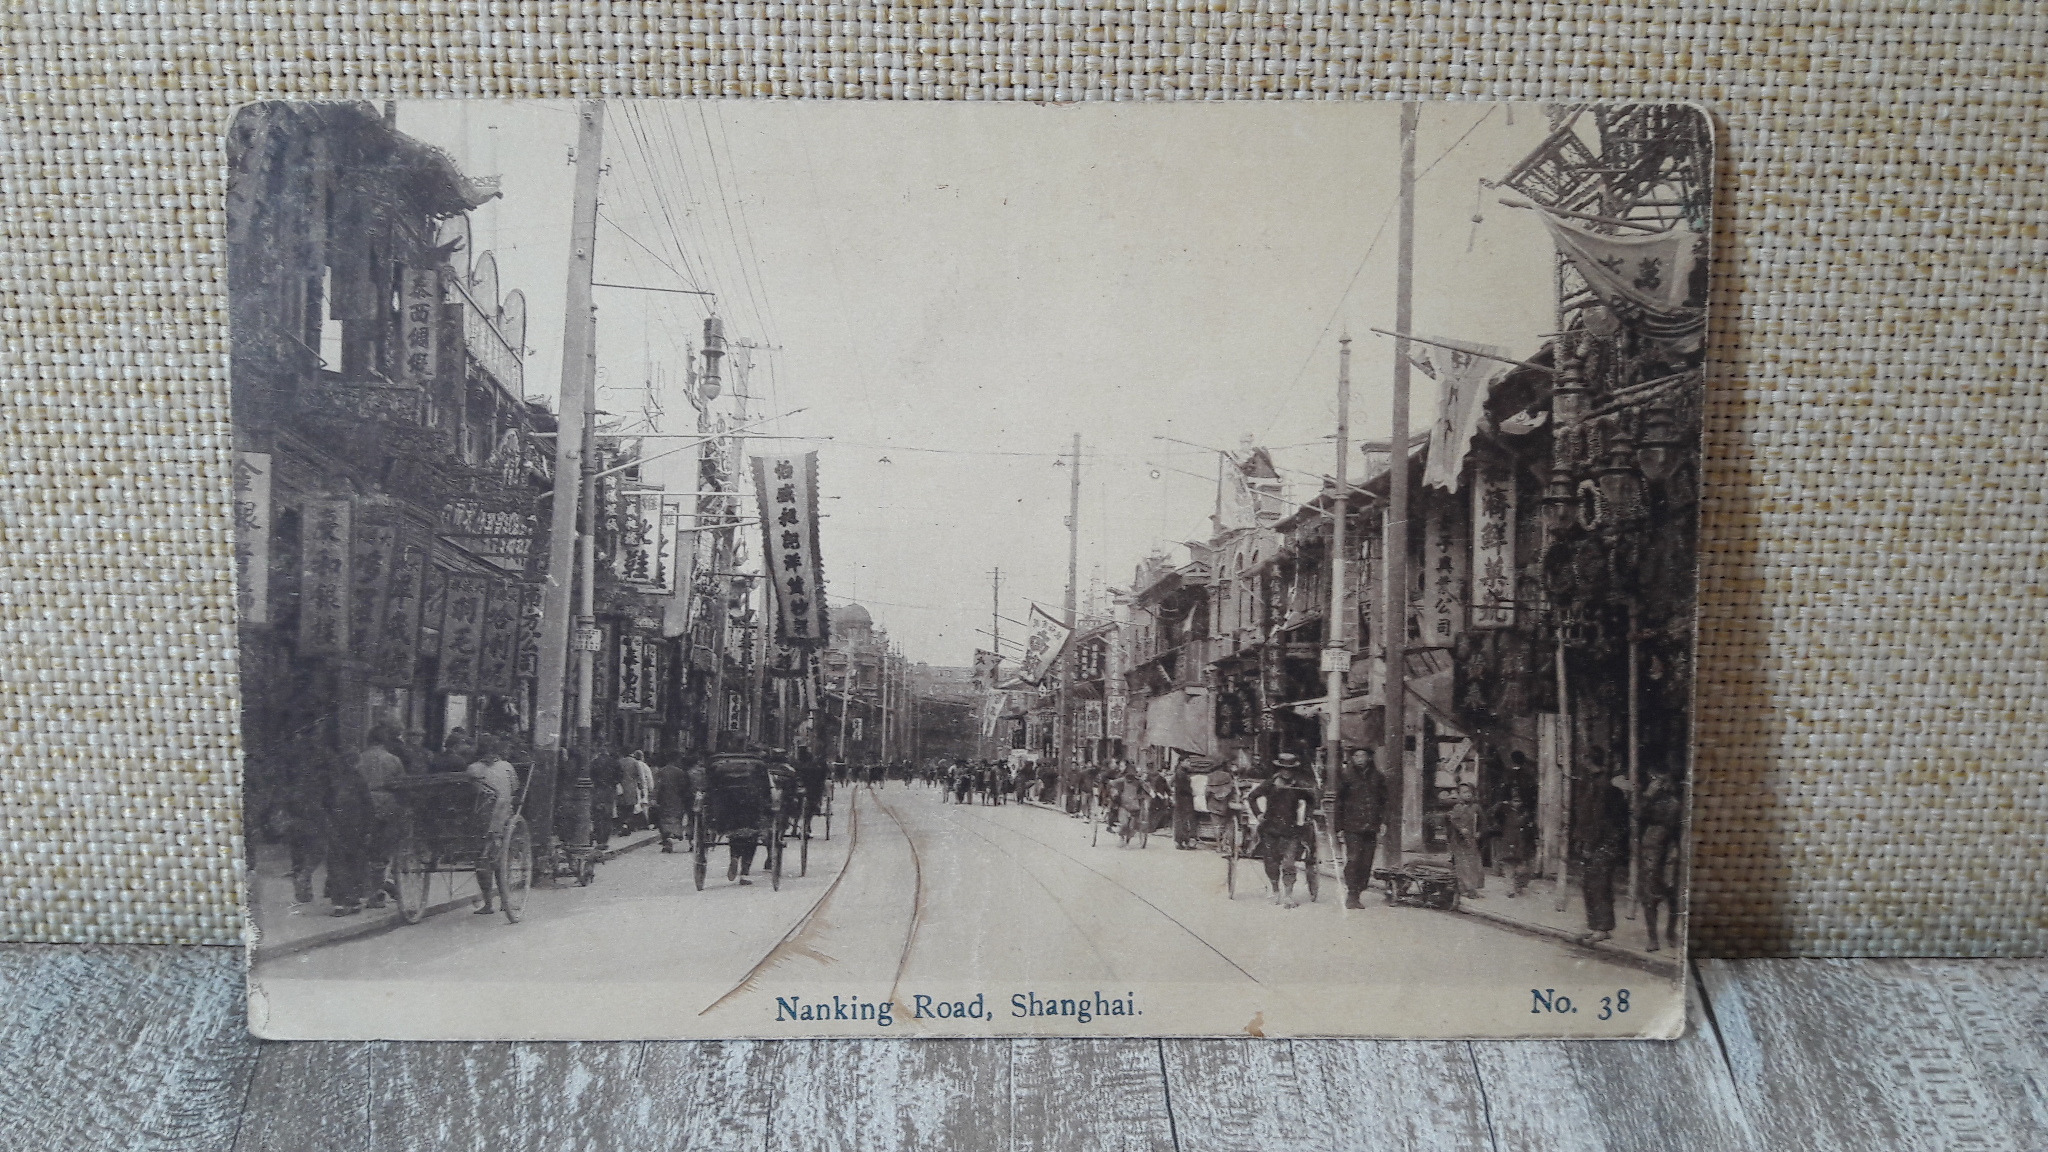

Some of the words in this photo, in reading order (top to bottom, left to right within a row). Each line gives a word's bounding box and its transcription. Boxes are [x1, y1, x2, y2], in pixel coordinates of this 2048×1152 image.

[774, 995, 896, 1027] Nanking
[912, 992, 994, 1022] Road,
[1010, 991, 1144, 1024] Shanghai.
[1530, 988, 1578, 1014] No.
[1597, 988, 1631, 1021] 38
